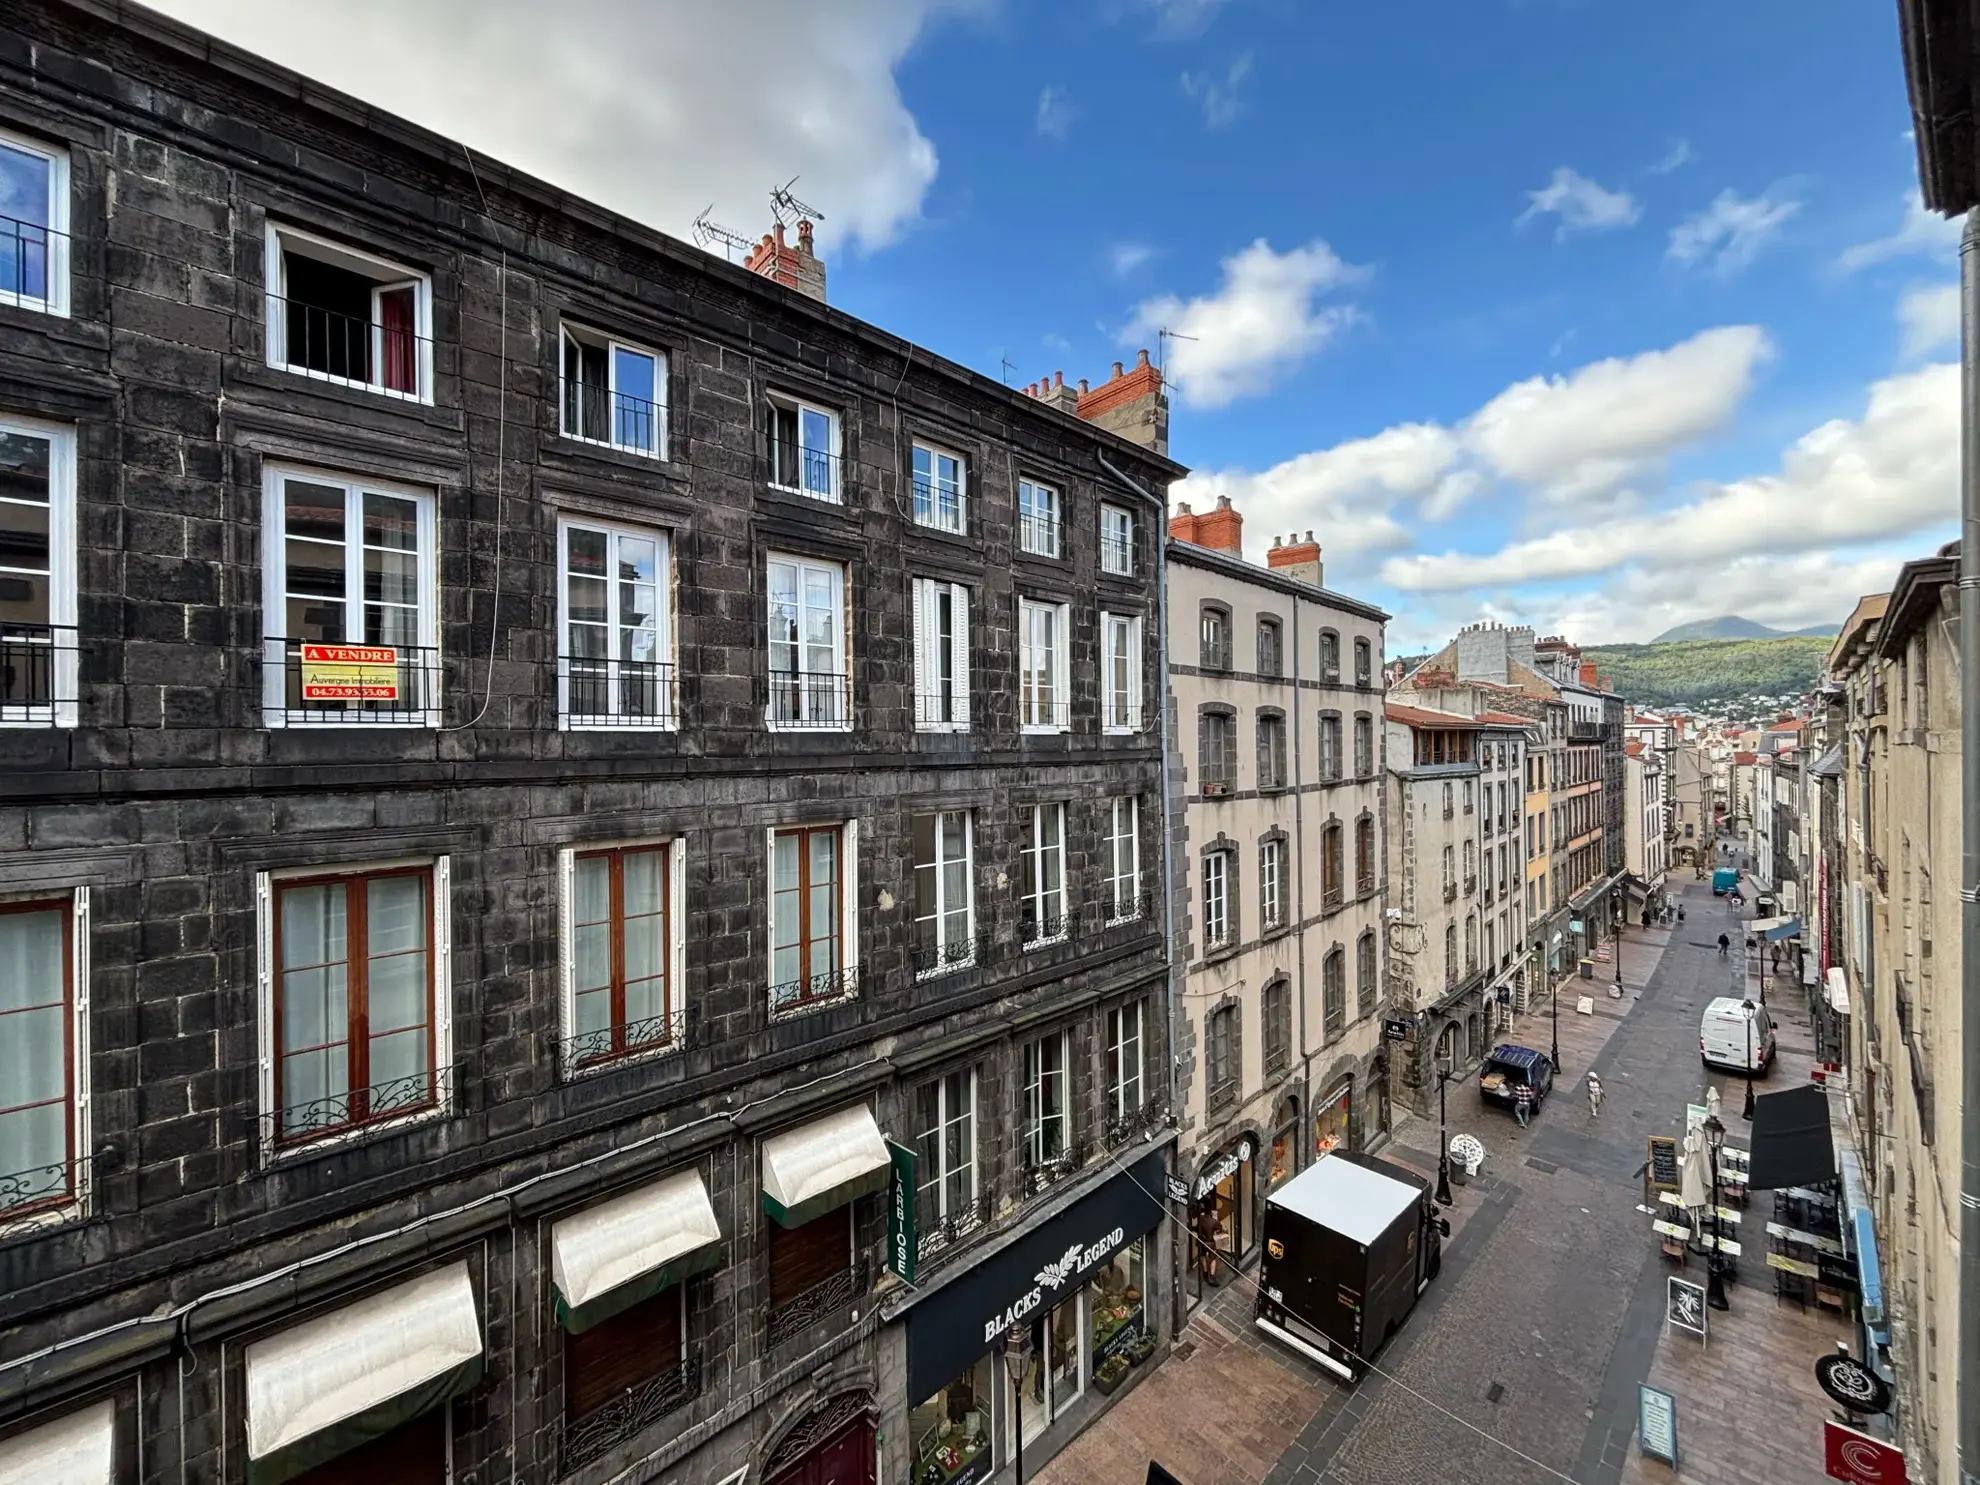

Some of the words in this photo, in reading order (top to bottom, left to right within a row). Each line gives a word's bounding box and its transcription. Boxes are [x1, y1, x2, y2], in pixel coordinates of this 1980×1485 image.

[308, 648, 320, 659] A
[325, 649, 393, 661] VENDRE
[310, 673, 350, 685] Auvergne
[1168, 1176, 1188, 1191] BLACKS
[1196, 1154, 1239, 1200] Acuitis
[1168, 1192, 1188, 1205] LEGEND
[896, 1167, 906, 1274] LARBIOSE
[984, 1286, 1042, 1343] BLACKS
[1076, 1227, 1124, 1274] LEGEND
